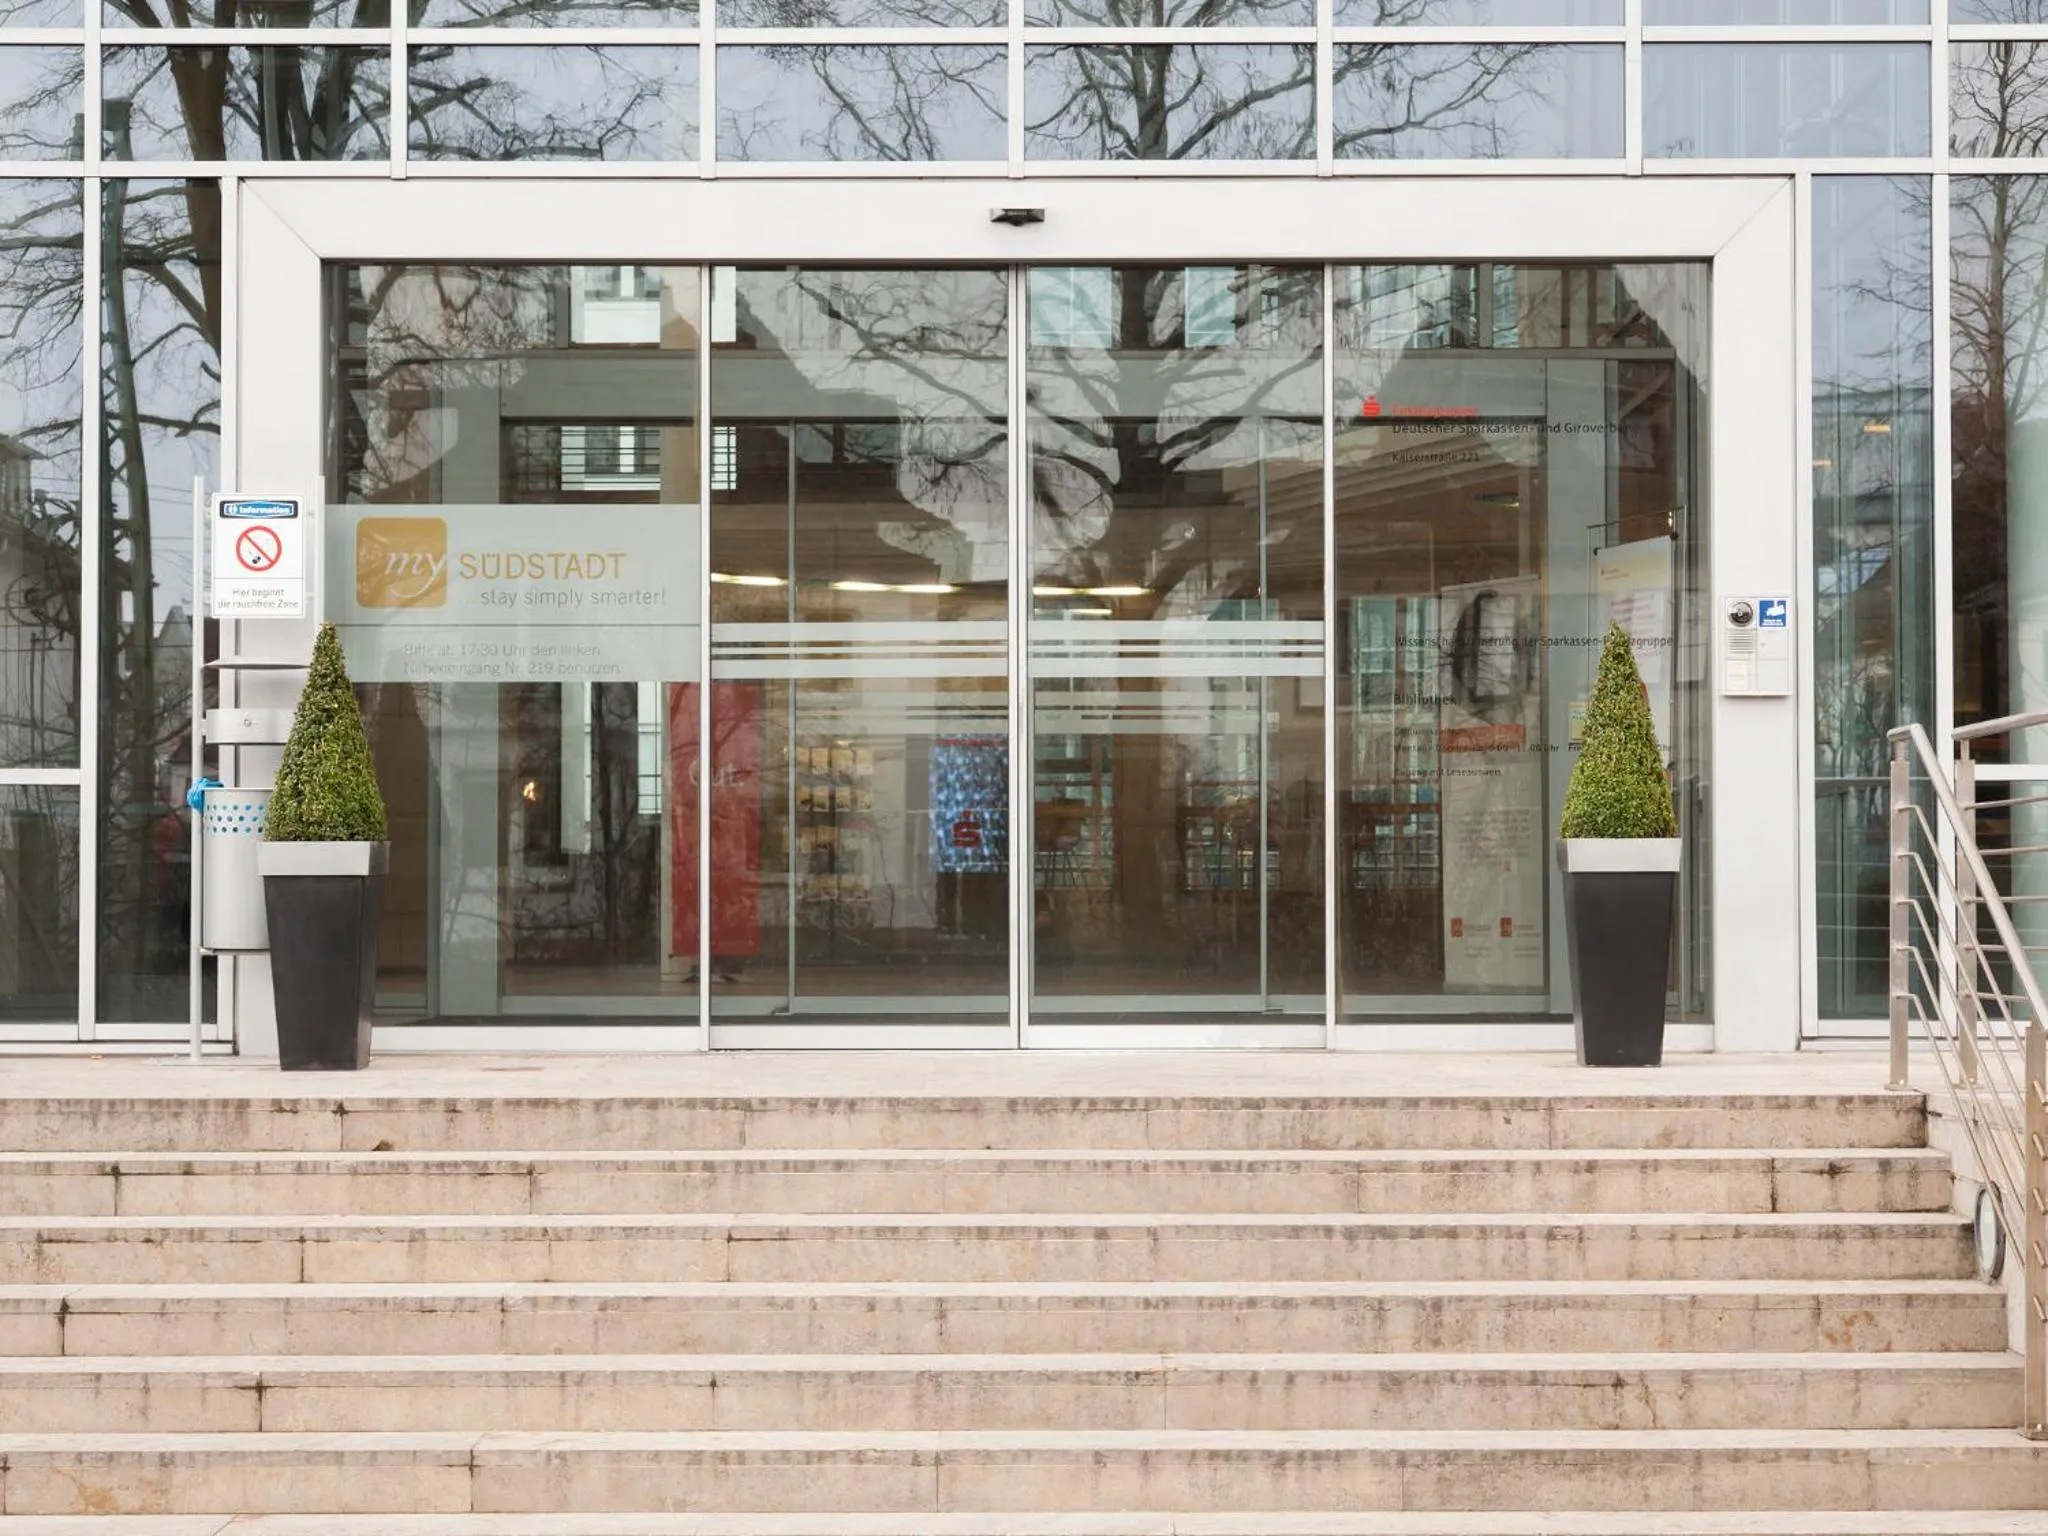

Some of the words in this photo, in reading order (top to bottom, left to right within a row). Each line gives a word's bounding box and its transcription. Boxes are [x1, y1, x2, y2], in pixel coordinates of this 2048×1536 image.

[1392, 422, 1456, 435] Deutscher
[1537, 421, 1561, 434] und
[1564, 421, 1632, 434] Giroverba
[384, 551, 447, 598] my
[458, 551, 627, 580] SÜDSTADT
[480, 589, 517, 608] stay
[523, 588, 583, 608] simply
[590, 588, 666, 605] smarter!
